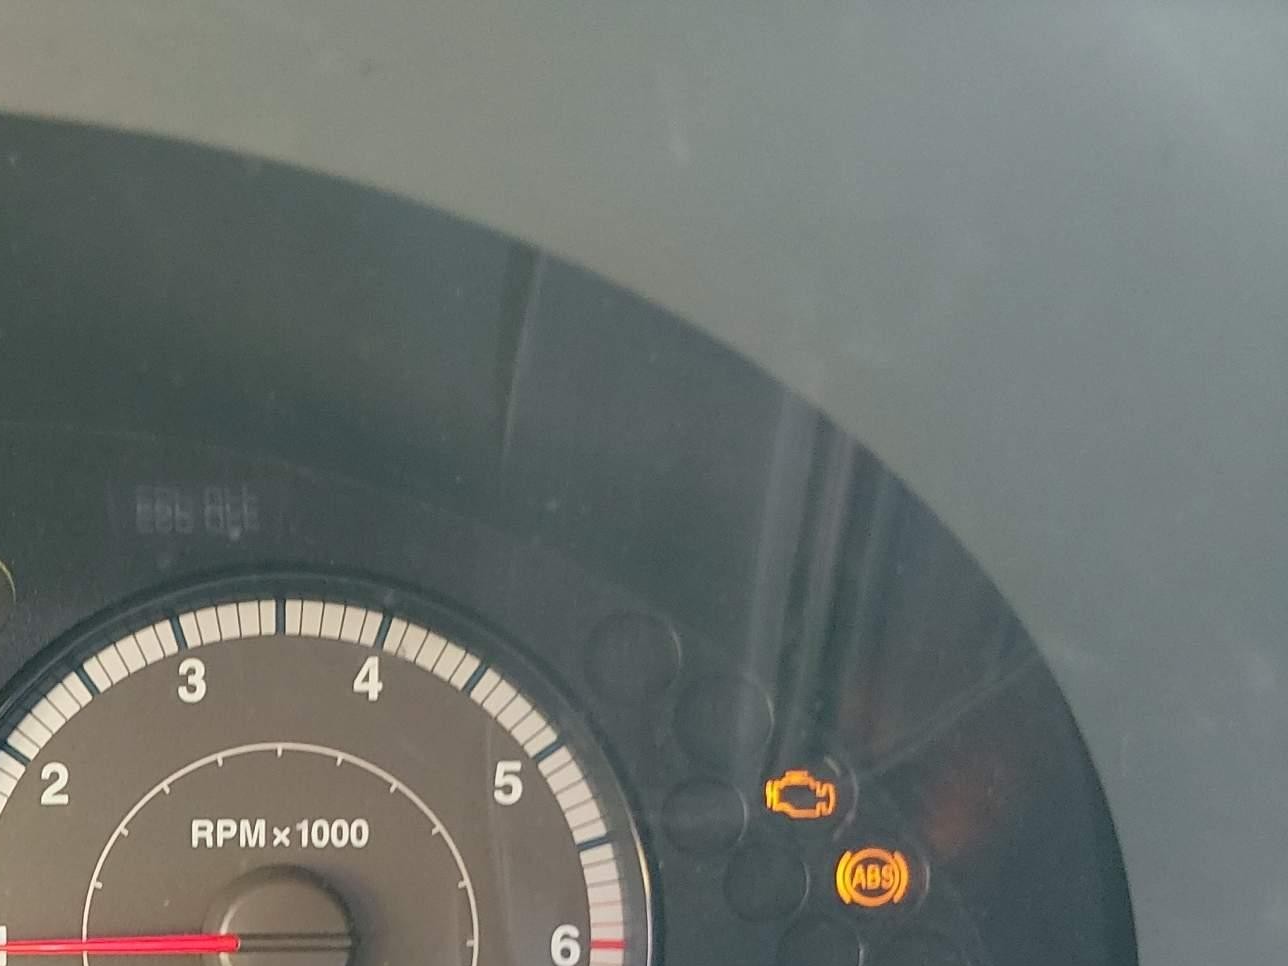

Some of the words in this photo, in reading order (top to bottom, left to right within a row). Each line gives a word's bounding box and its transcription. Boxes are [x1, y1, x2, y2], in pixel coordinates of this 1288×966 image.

[177, 658, 207, 703] 3
[353, 656, 383, 701] 4
[40, 762, 69, 805] 2
[493, 761, 523, 805] 5
[852, 862, 896, 891] ABS
